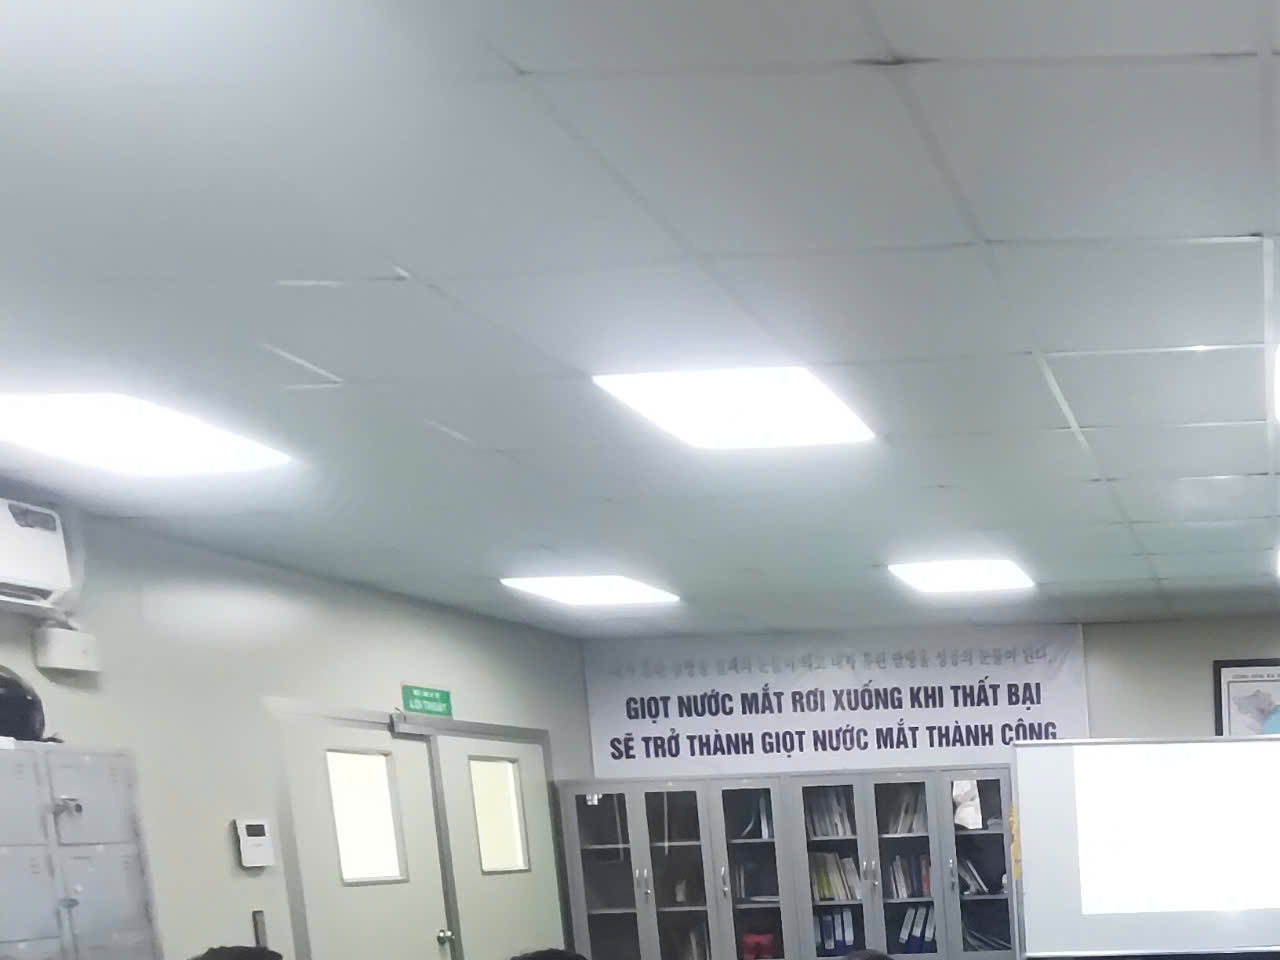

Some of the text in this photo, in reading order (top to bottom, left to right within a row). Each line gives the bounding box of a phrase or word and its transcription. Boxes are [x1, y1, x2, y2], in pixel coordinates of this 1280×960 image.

[626, 676, 1042, 724] GIỌT NƯỚC MẮT RƠI XUỐNG KHI THẤT BẠI
[610, 732, 636, 760] SẼ
[641, 728, 681, 759] TRỞ
[686, 728, 755, 757] THÀNH
[761, 730, 806, 758] GIỌT
[813, 724, 869, 752] NƯỚC
[876, 718, 919, 750] MẮT
[926, 720, 994, 748] THÀNH
